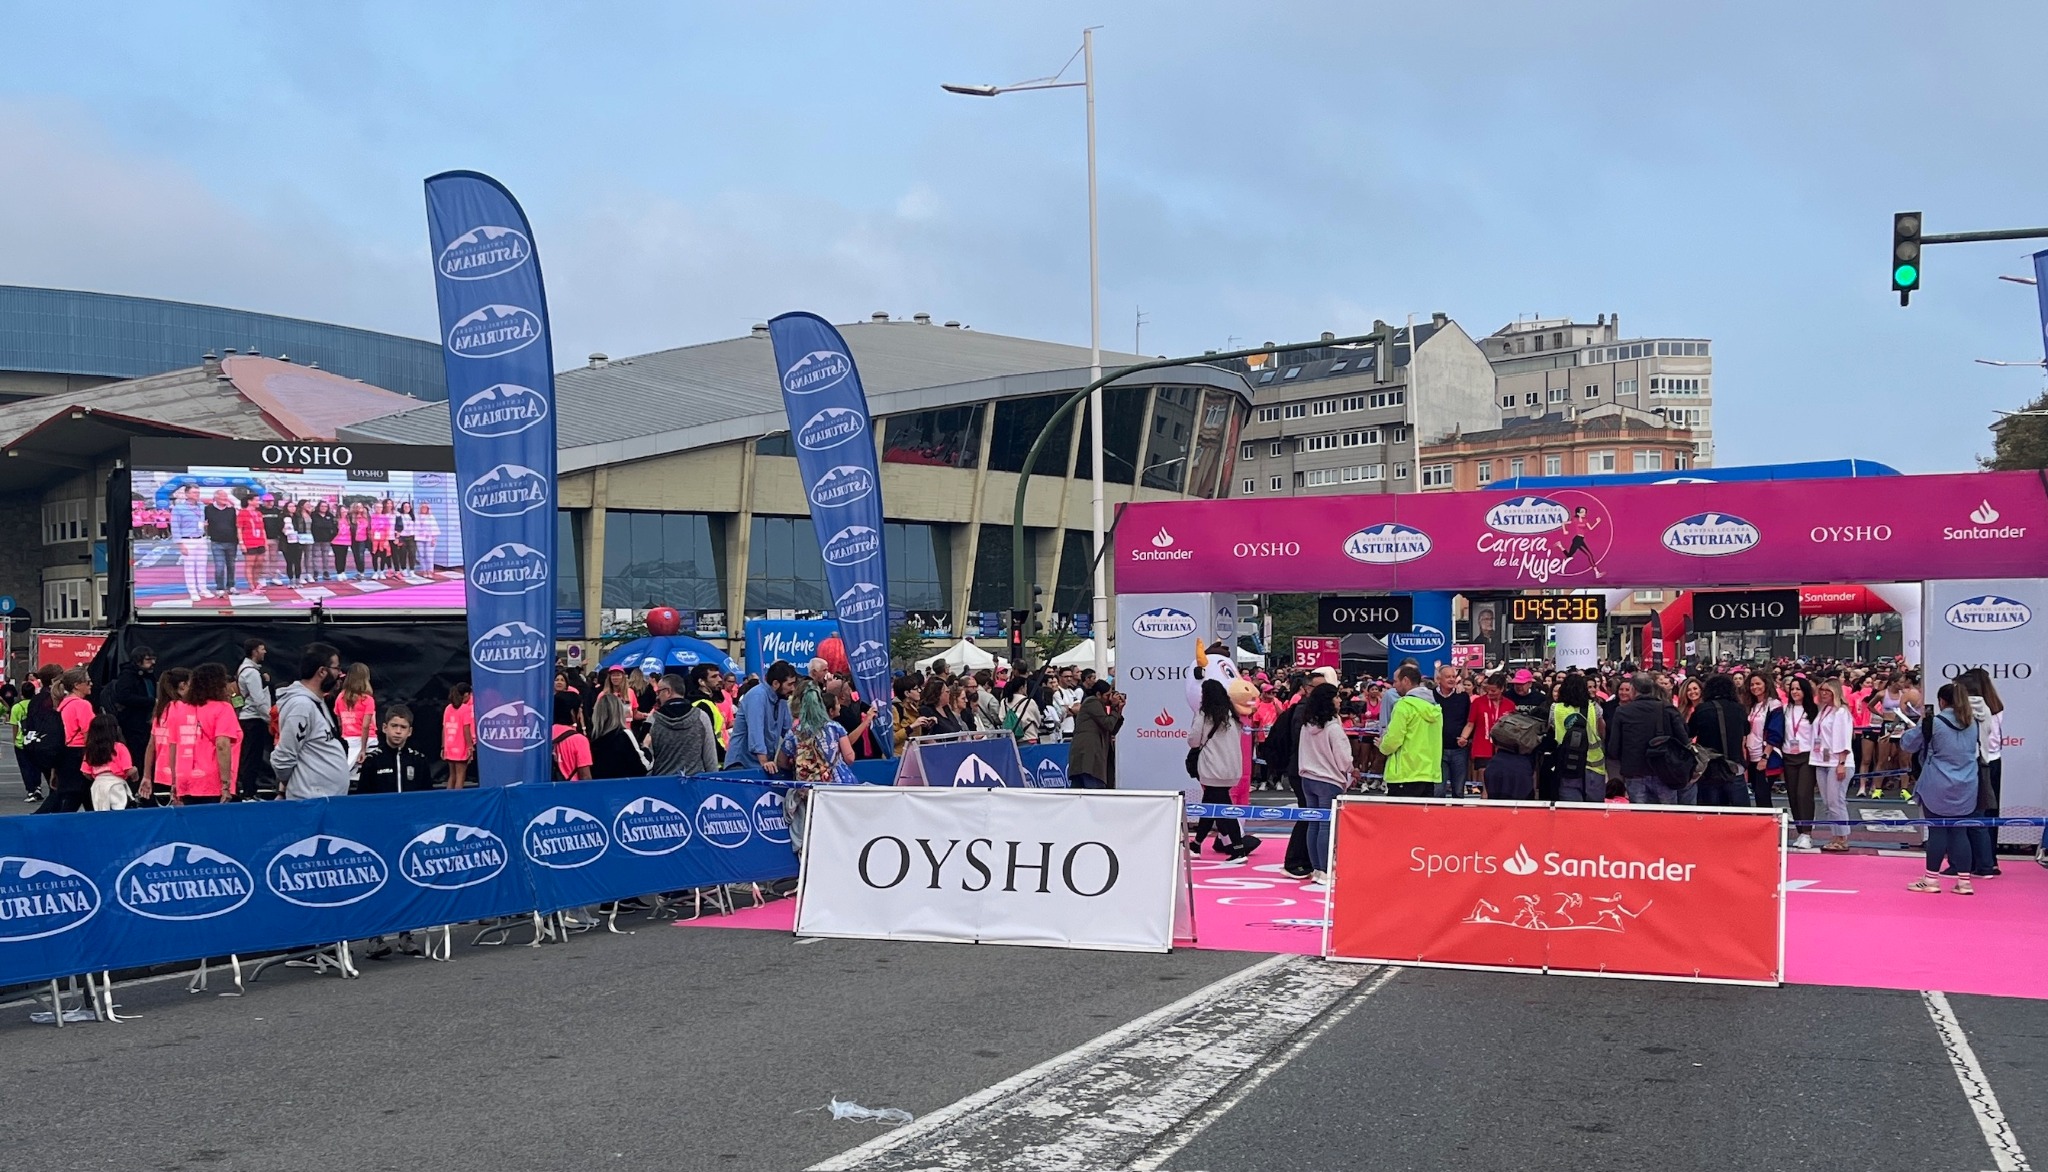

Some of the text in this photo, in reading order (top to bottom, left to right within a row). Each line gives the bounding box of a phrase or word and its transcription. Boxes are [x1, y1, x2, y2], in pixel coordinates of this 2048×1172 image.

[261, 445, 353, 466] OYSHO
[1491, 510, 1563, 526] ASTURIANA
[1669, 530, 1752, 545] ASTURIANA
[1810, 525, 1893, 543] OYSHO
[1943, 525, 2027, 540] Santander
[1233, 542, 1301, 557] OYSHO
[1350, 539, 1425, 554] ASTURIANA
[1477, 532, 1548, 553] Carrera
[1132, 549, 1193, 561] Santander
[1493, 549, 1574, 583] de la Mujer
[1805, 592, 1856, 602] Santander
[1333, 607, 1399, 622] OYSHO
[1513, 598, 1598, 620] 09:52:36
[1709, 601, 1784, 620] OYSHO
[1952, 609, 2025, 623] ASTURIANA
[1137, 620, 1192, 632] ASTURIANA
[763, 632, 815, 660] Marlene
[1296, 640, 1319, 650] SUB
[1395, 634, 1441, 646] ASTURIANA
[1451, 647, 1468, 655] SUB
[1559, 648, 1590, 656] OYSHO
[1942, 663, 2032, 679] OHO
[1137, 728, 1189, 738] Santande
[703, 814, 749, 835] ASTURIANA
[757, 812, 788, 831] ASTURI
[621, 820, 687, 843] ASTURIANA
[532, 832, 604, 857] ASTURIANA
[291, 859, 332, 870] CENTRAL
[410, 848, 502, 878] ASTURIANA
[858, 836, 1120, 897] OYSHO
[1409, 846, 1696, 882] Sports Santander
[145, 866, 237, 879] CENTRAL LECHERA
[278, 864, 381, 891] ASTURIANA
[27, 879, 81, 891] LECHERA
[128, 874, 246, 905] ASTURIANA
